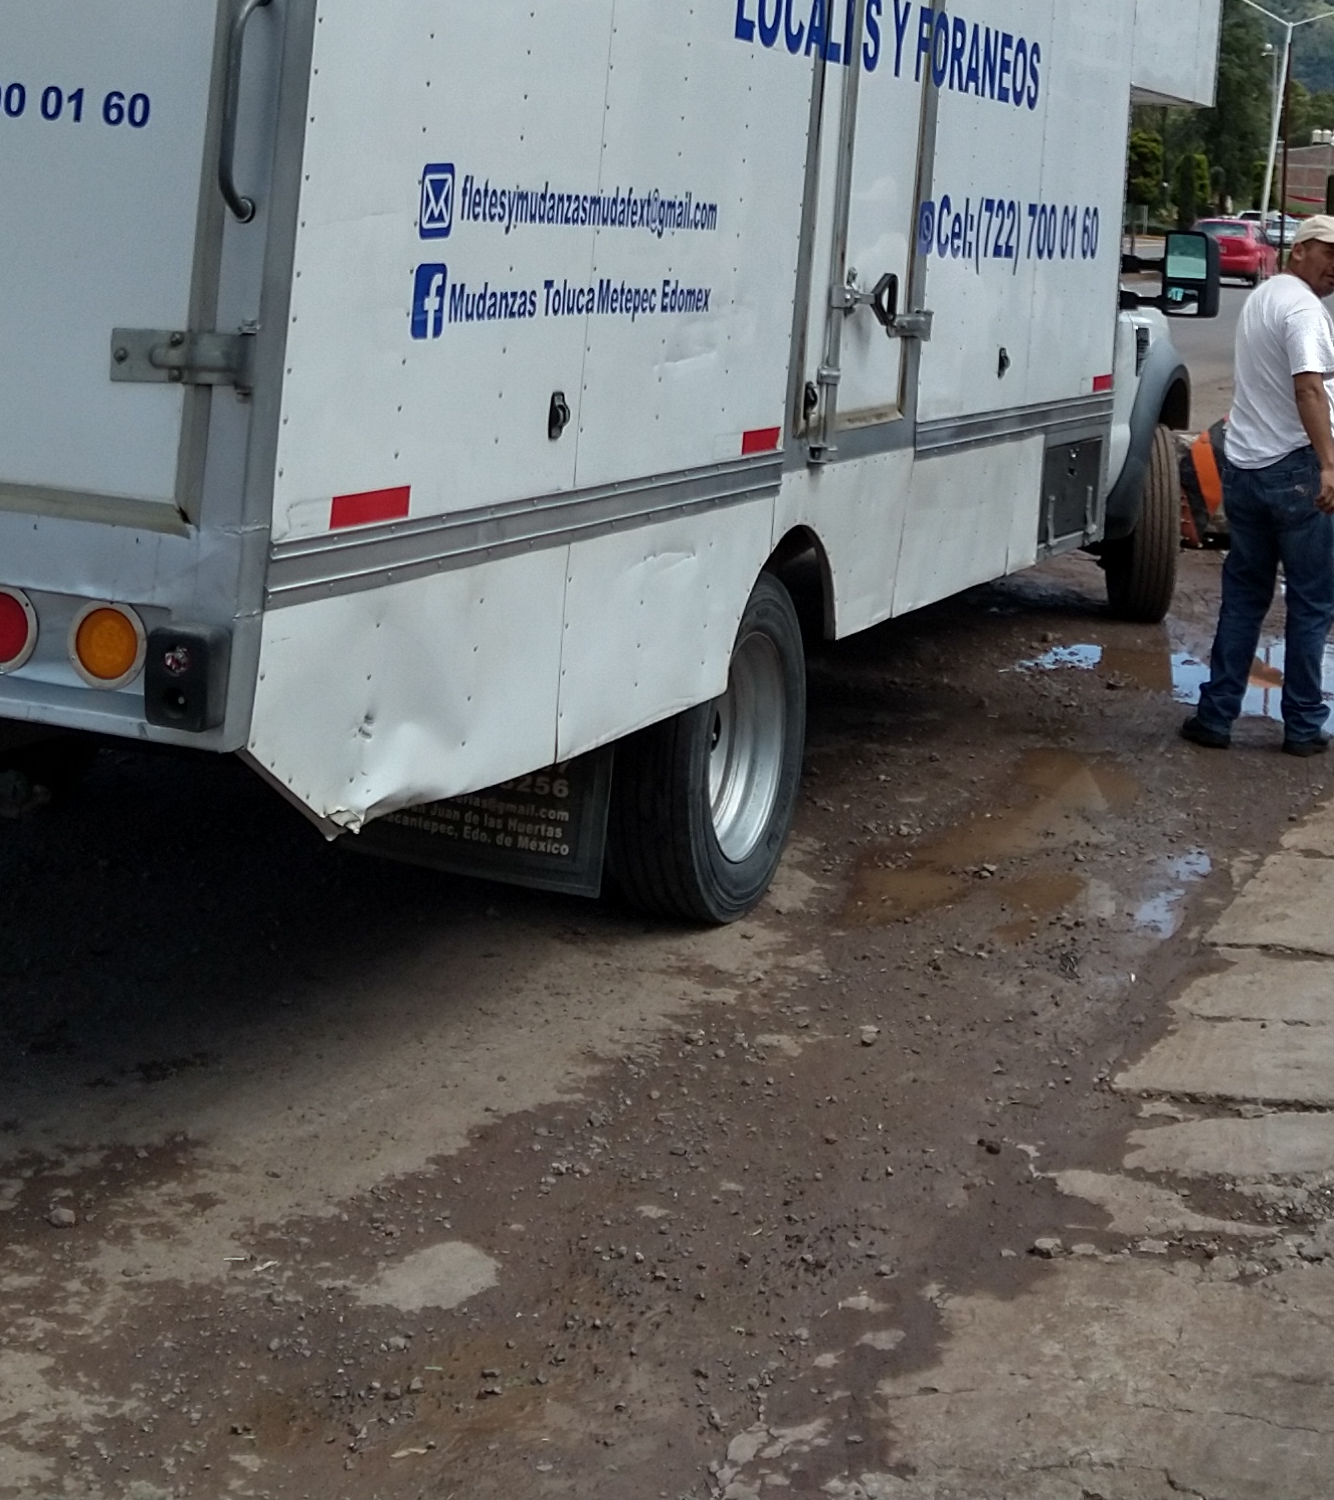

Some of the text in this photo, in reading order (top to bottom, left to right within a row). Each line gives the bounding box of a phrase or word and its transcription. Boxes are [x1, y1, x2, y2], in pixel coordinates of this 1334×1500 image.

[914, 5, 1041, 112] FORANEOS
[40, 85, 85, 123] 01
[102, 90, 151, 128] 60
[461, 175, 718, 238] fletesymudanzasmudafext@gmail.com
[1027, 203, 1057, 260] 700
[1060, 204, 1078, 260] 01
[1082, 206, 1099, 260] 60
[448, 279, 712, 323] Mudanzas Toluca Metepec Edomex
[499, 775, 569, 798] 256
[430, 802, 461, 821] Juan
[465, 810, 480, 825] de
[484, 813, 503, 829] las
[463, 825, 491, 844] Edo.
[496, 831, 513, 848] de
